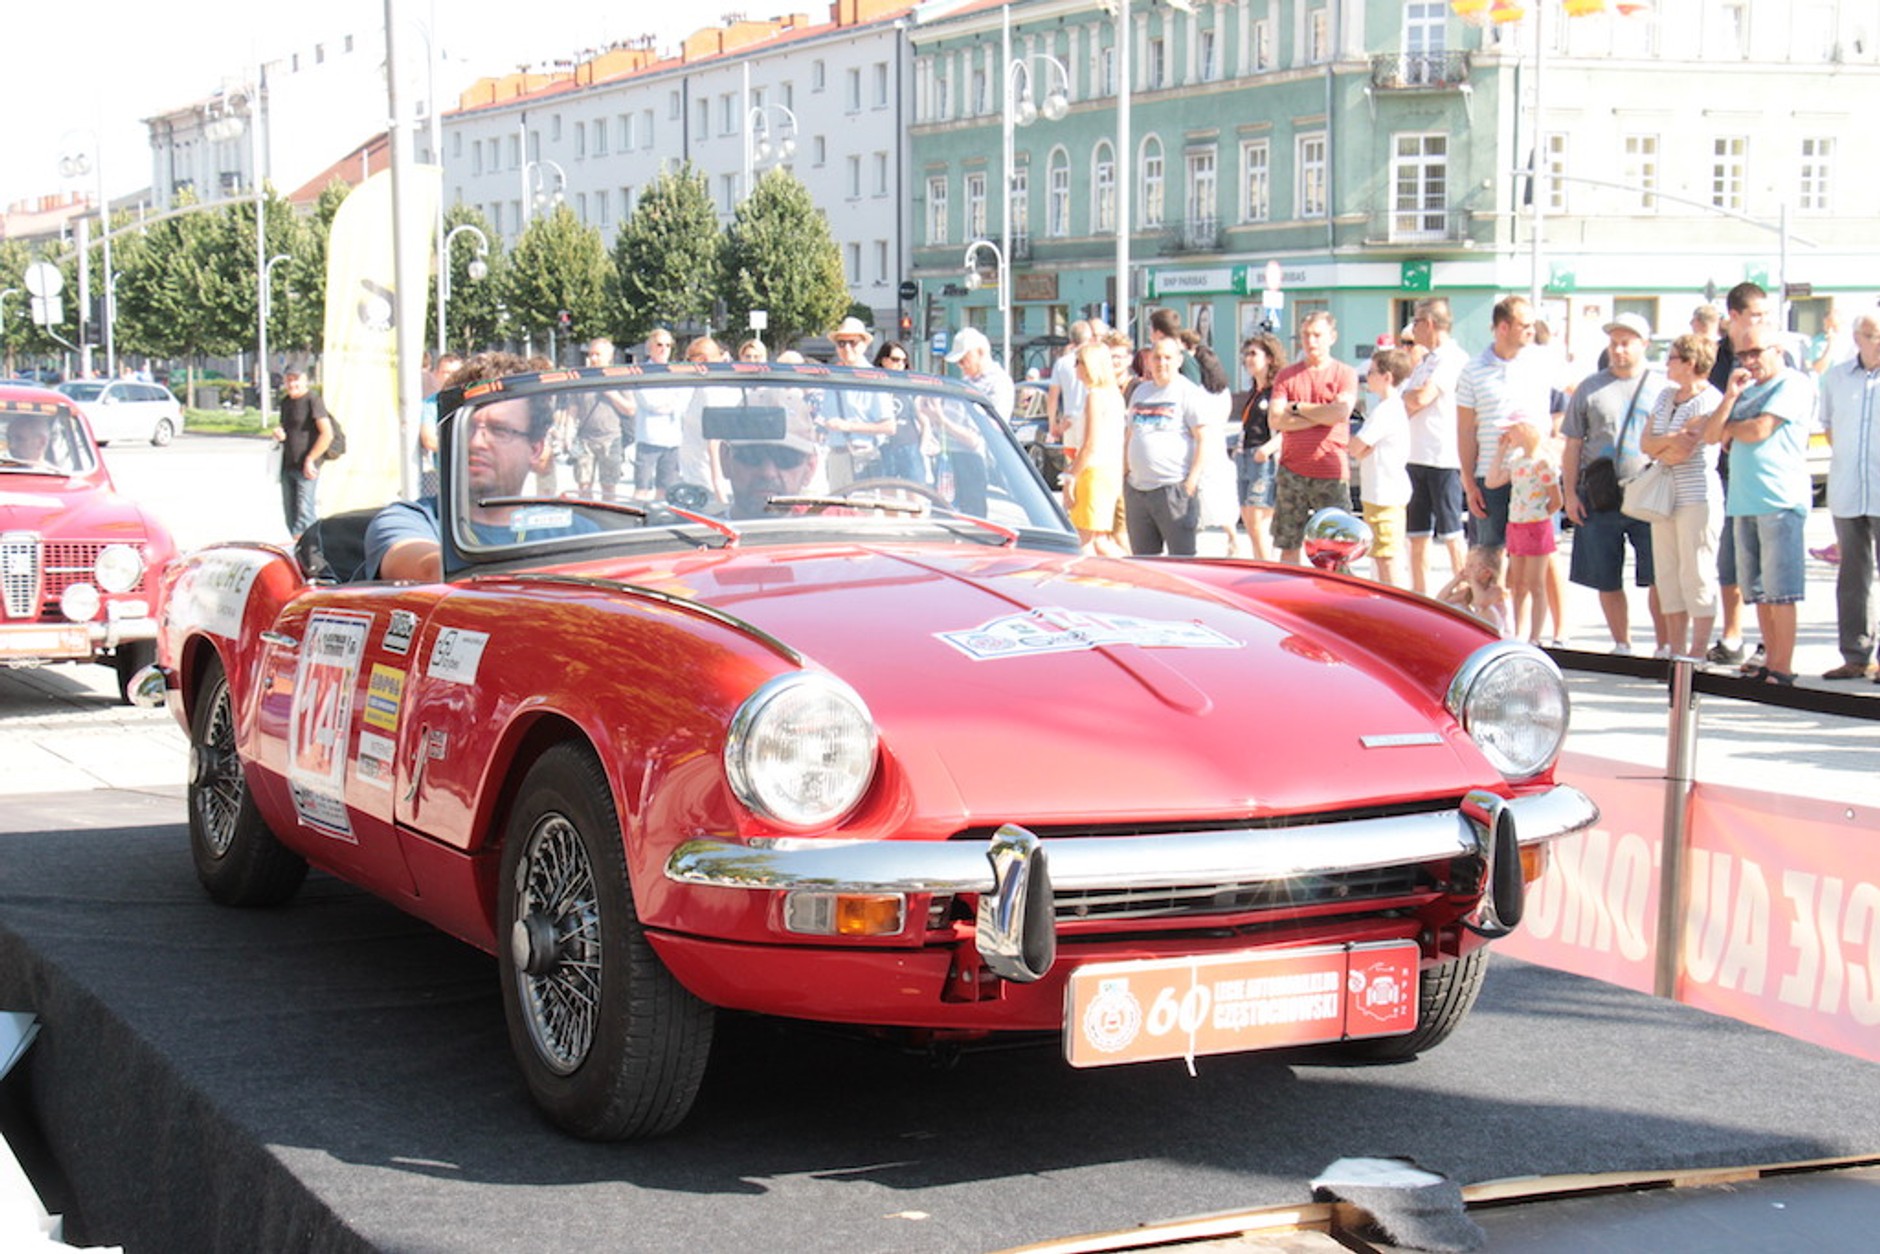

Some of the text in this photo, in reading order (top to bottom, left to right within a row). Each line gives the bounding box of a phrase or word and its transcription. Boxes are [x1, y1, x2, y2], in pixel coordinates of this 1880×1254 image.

[1178, 275, 1208, 286] PARIBAS
[1146, 984, 1211, 1036] 60
[1213, 992, 1339, 1032] CZĘSTOCHOWSKI
